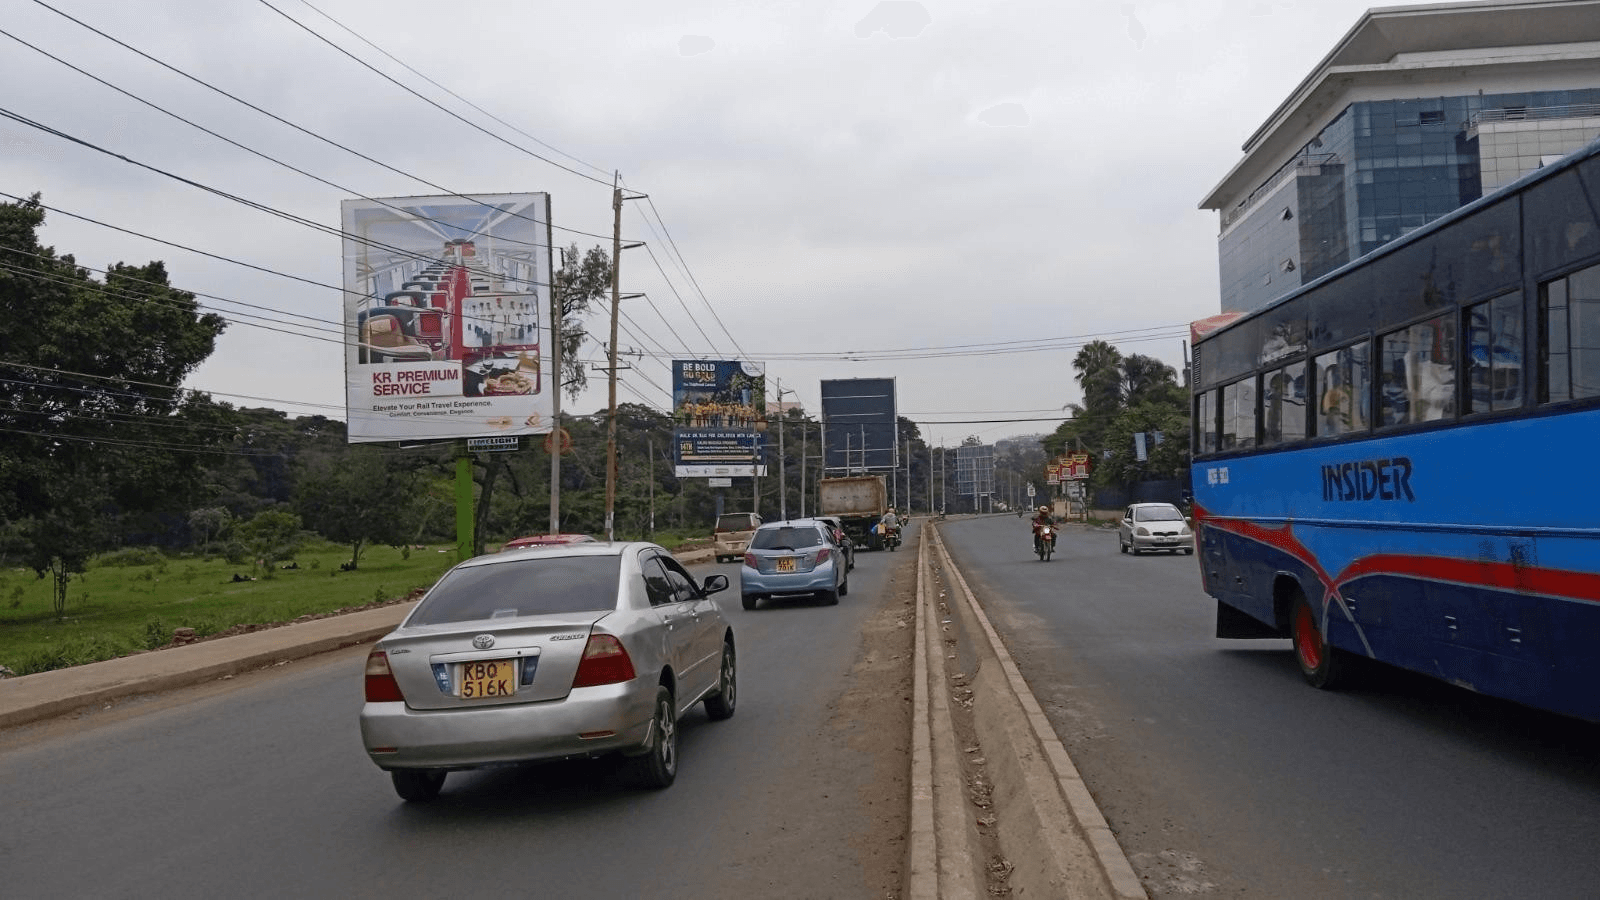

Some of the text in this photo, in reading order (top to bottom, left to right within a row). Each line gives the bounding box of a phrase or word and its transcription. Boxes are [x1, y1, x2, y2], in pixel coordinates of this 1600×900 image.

[683, 363, 715, 371] BE BOLD
[373, 369, 458, 384] KR PREMIUM
[373, 382, 430, 396] SERVICE
[372, 404, 398, 412] Elevate
[399, 402, 415, 410] Your
[416, 402, 430, 410] Rail
[431, 401, 452, 409] Travel
[469, 437, 517, 445] LIMELIGHT
[1321, 457, 1416, 503] INSIDER
[464, 662, 498, 681] KBQ
[463, 679, 508, 697] 516K
